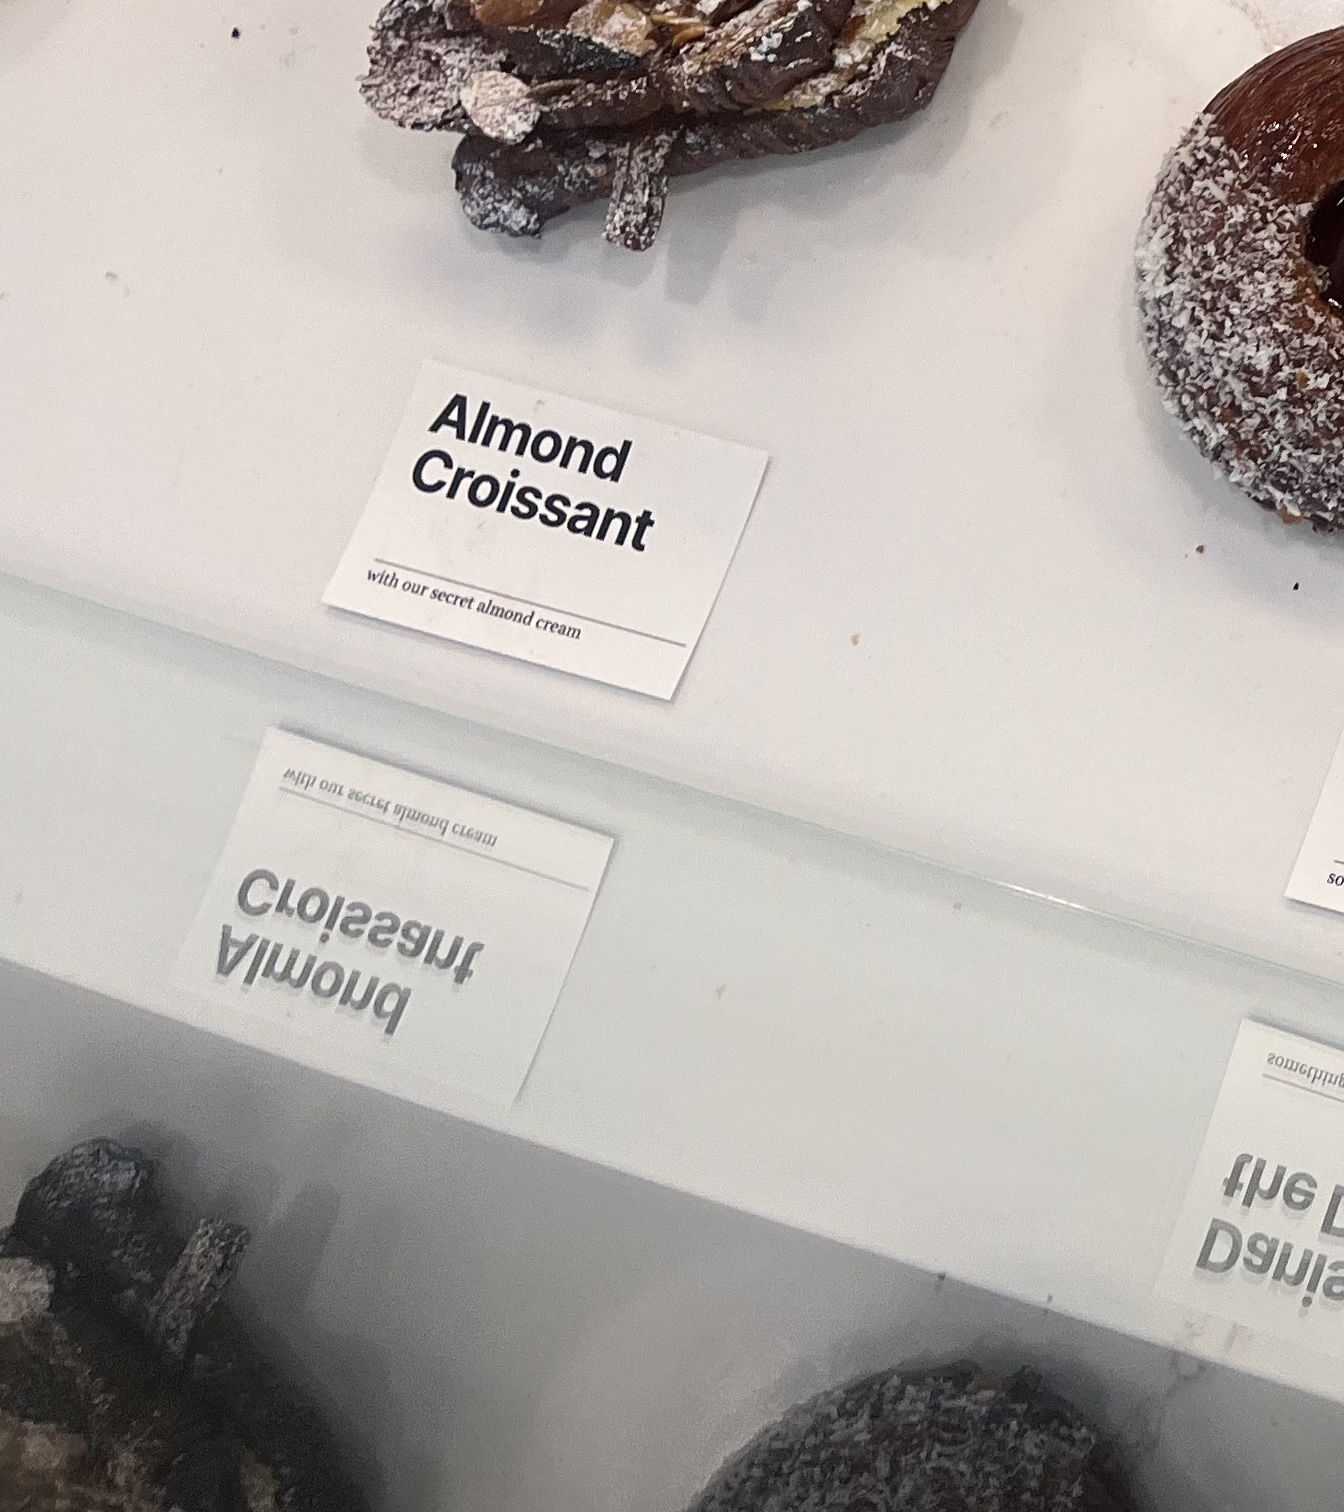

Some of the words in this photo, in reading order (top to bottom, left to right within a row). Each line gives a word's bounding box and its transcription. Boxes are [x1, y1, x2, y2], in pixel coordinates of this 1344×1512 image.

[428, 393, 633, 483] Almond
[411, 449, 655, 552] Croissant
[367, 568, 399, 590] with
[402, 578, 429, 597] our
[430, 588, 475, 611] secret
[476, 599, 535, 627] almond
[535, 616, 582, 640] cream
